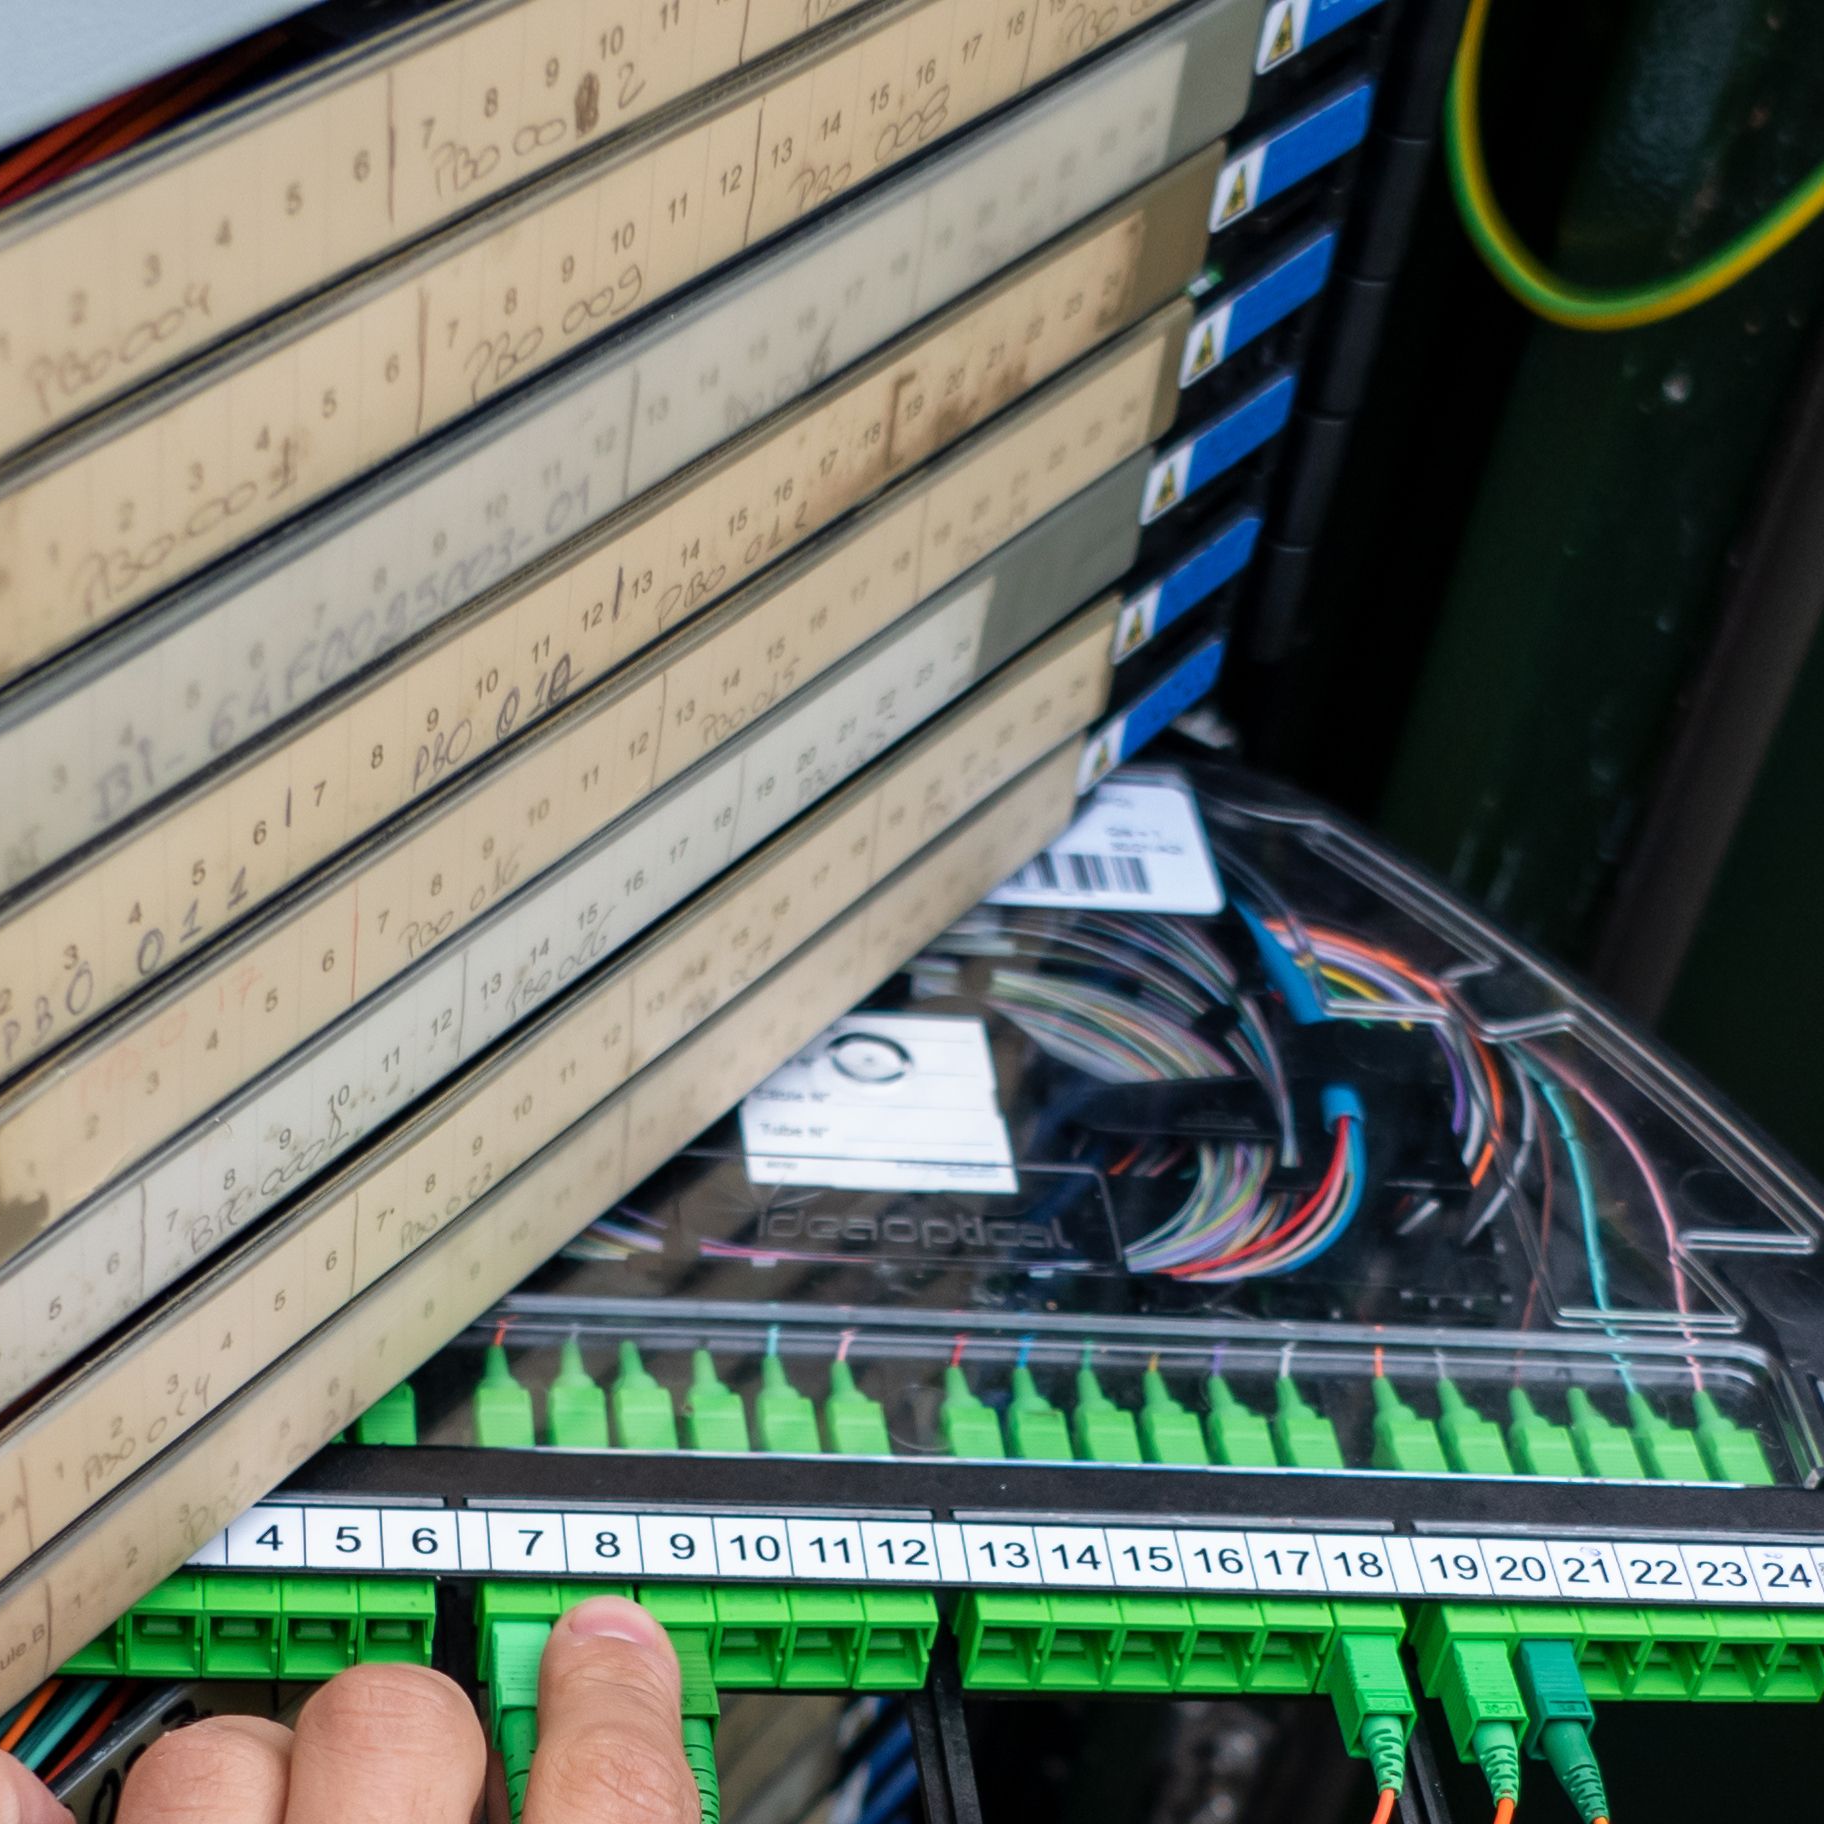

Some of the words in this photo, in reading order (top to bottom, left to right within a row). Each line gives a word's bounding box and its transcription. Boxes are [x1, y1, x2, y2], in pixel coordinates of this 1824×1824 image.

[255, 426, 271, 451] 4
[322, 389, 338, 419] 5
[384, 354, 400, 384] 6
[447, 318, 460, 349] 7
[503, 287, 518, 316] 8
[561, 254, 576, 284] 9
[611, 221, 636, 254] 10
[668, 192, 688, 224] 11
[720, 163, 743, 196] 12
[771, 136, 793, 168] 13
[821, 110, 842, 141] 14
[869, 82, 890, 115] 15
[916, 58, 937, 89] 16
[961, 32, 983, 64] 17
[1006, 9, 1026, 39] 18
[286, 183, 303, 216] 5
[352, 150, 370, 183] 6
[422, 117, 436, 149] 7
[483, 87, 499, 118] 8
[544, 56, 560, 88] 9
[599, 24, 625, 60] 10
[63, 944, 80, 971] 3
[127, 901, 143, 925] 4
[191, 859, 207, 887] 5
[252, 820, 267, 846] 6
[313, 779, 327, 807] 7
[370, 744, 384, 770] 8
[426, 707, 440, 733] 9
[475, 667, 499, 700] 10
[531, 634, 551, 664] 11
[581, 601, 604, 632] 12
[631, 569, 653, 600] 13
[680, 538, 701, 568] 14
[727, 507, 748, 538] 15
[773, 477, 794, 506] 16
[818, 448, 844, 483] 17
[863, 420, 883, 447] 18
[904, 393, 925, 422] 19
[658, 564, 726, 630] PBO
[265, 987, 279, 1013] 5
[321, 948, 335, 973] 6
[377, 908, 390, 934] 7
[429, 873, 443, 897] 8
[481, 836, 495, 861] 9
[527, 797, 551, 827] 10
[581, 764, 600, 792] 11
[628, 730, 650, 760] 12
[675, 698, 696, 726] 13
[721, 668, 741, 694] 14
[766, 636, 786, 663] 15
[48, 1296, 63, 1321] 5
[105, 1251, 121, 1275] 6
[166, 1208, 179, 1233] 7
[222, 1168, 237, 1191] 8
[278, 1127, 292, 1151] 9
[327, 1084, 351, 1115] 10
[381, 1045, 401, 1073] 11
[430, 1007, 453, 1037] 12
[480, 971, 502, 1001] 13
[529, 937, 550, 965] 14
[577, 902, 598, 930] 15
[624, 869, 645, 896] 16
[669, 836, 690, 864] 17
[713, 806, 733, 831] 18
[756, 775, 776, 801] 19
[110, 1415, 124, 1440] 2
[166, 1373, 180, 1396] 3
[220, 1331, 233, 1351] 4
[273, 1289, 286, 1312] 5
[325, 1250, 338, 1272] 6
[424, 1173, 437, 1194] 8
[471, 1135, 484, 1157] 9
[512, 1094, 533, 1122] 10
[559, 1059, 577, 1084] 11
[32, 1621, 46, 1642] B
[255, 1524, 283, 1551] 4
[335, 1526, 362, 1553] 5
[411, 1527, 439, 1555] 6
[518, 1529, 544, 1556] 7
[595, 1531, 621, 1558] 8
[669, 1533, 696, 1560] 9
[730, 1534, 781, 1562] 10
[809, 1536, 851, 1564] 11
[877, 1538, 929, 1566] 12
[979, 1541, 1030, 1569] 13
[1051, 1543, 1101, 1571] 14
[1123, 1545, 1174, 1573] 15
[1194, 1547, 1244, 1575] 16
[1264, 1549, 1310, 1576] 17
[1334, 1551, 1384, 1578] 18
[1430, 1553, 1479, 1580] 19
[1495, 1555, 1547, 1582] 20
[1563, 1557, 1610, 1584] 21
[1630, 1559, 1683, 1586] 22
[1696, 1560, 1748, 1587] 23
[1762, 1562, 1813, 1588] 24
